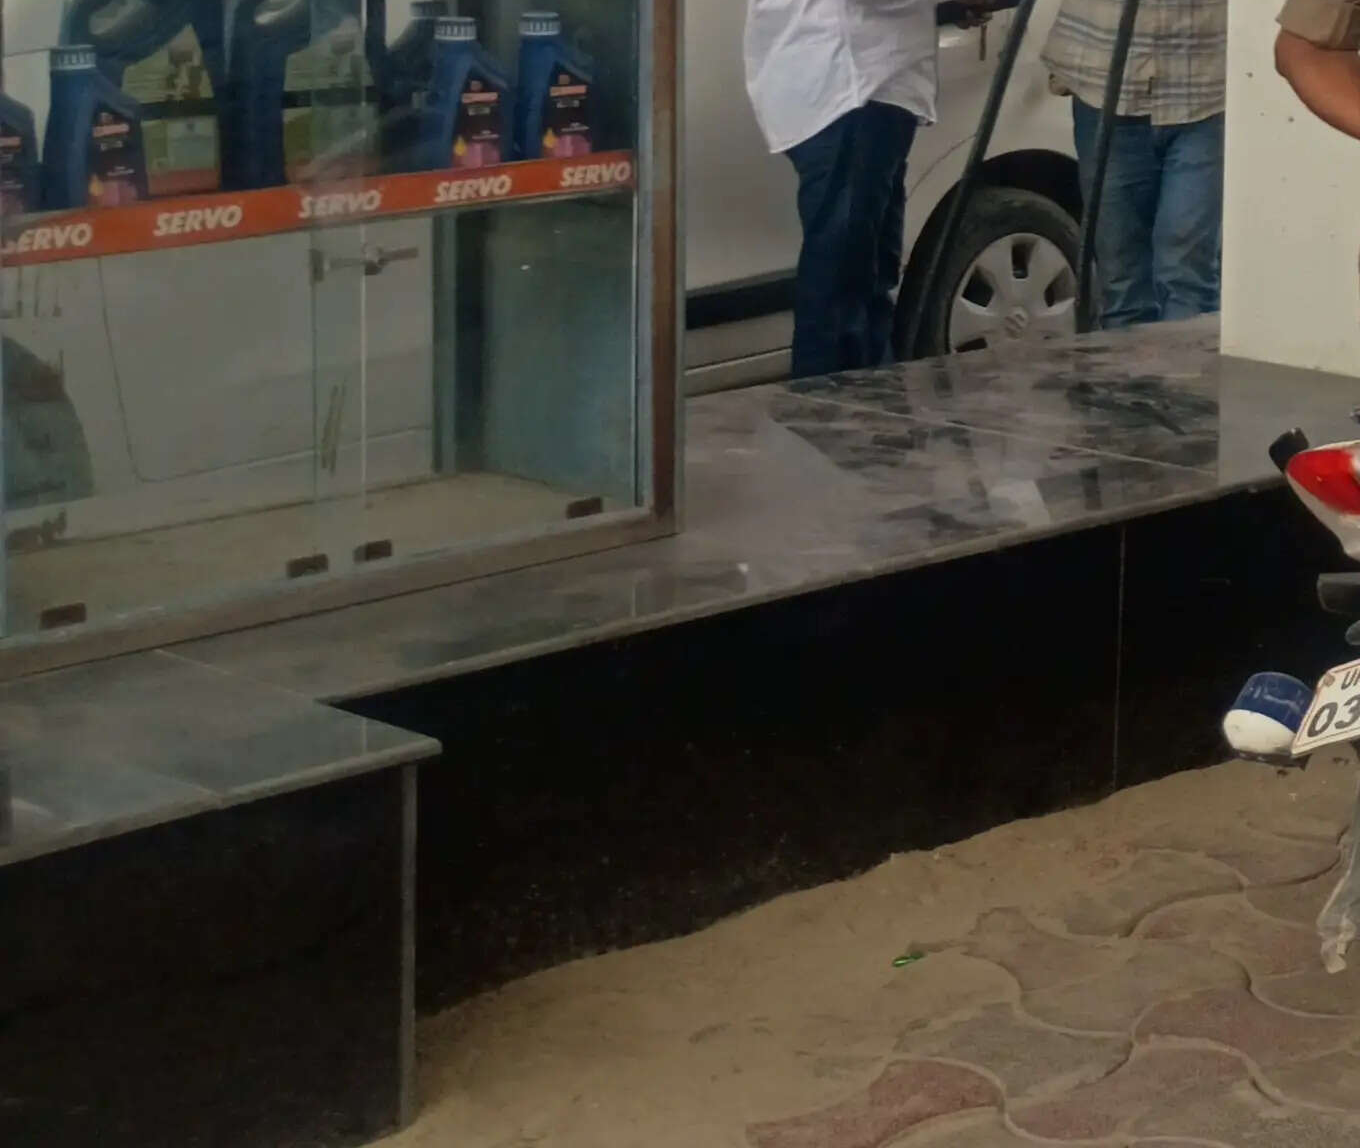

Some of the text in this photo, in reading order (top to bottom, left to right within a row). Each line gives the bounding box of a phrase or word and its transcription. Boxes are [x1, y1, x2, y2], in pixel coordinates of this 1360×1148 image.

[153, 204, 243, 237] SERVO
[298, 189, 382, 219] SERVO
[435, 174, 512, 203] SERVO
[560, 160, 632, 188] SERVO
